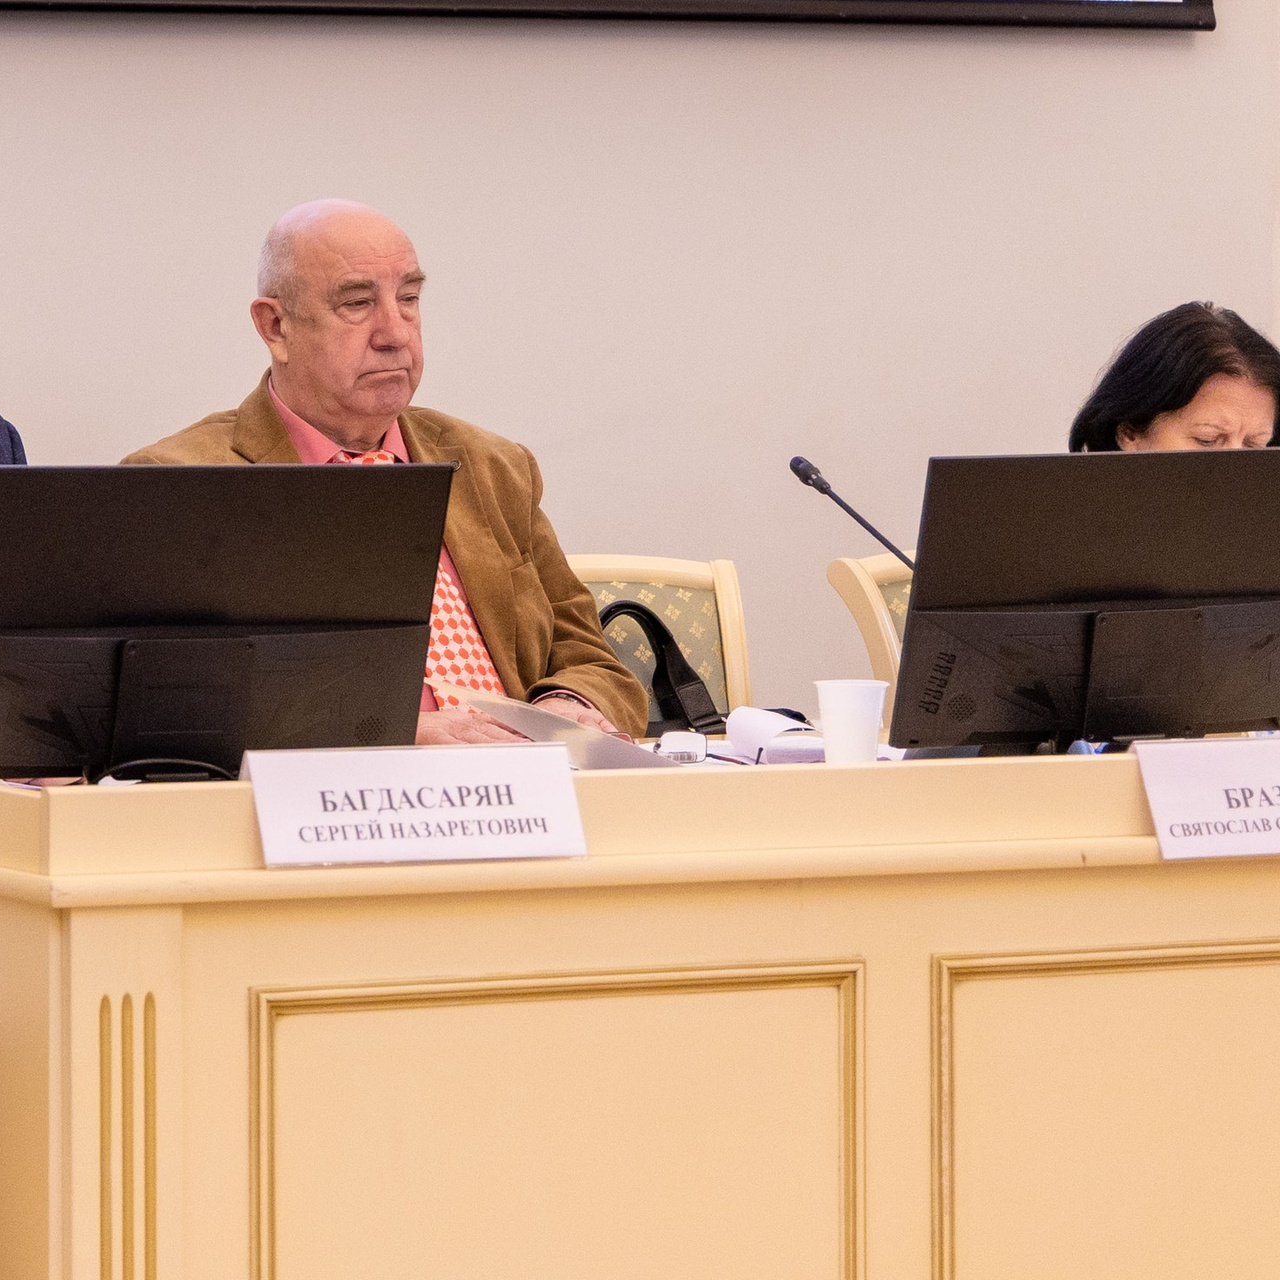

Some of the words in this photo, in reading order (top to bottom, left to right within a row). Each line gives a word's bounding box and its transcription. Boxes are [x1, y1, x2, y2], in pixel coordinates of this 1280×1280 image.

[318, 783, 516, 816] БАГДАСАРЯН
[297, 819, 385, 844] СЕРГЕЙ
[390, 816, 549, 840] НАЗАРЕТОВИЧ
[1169, 817, 1273, 838] СВЯТОСЛАВ
